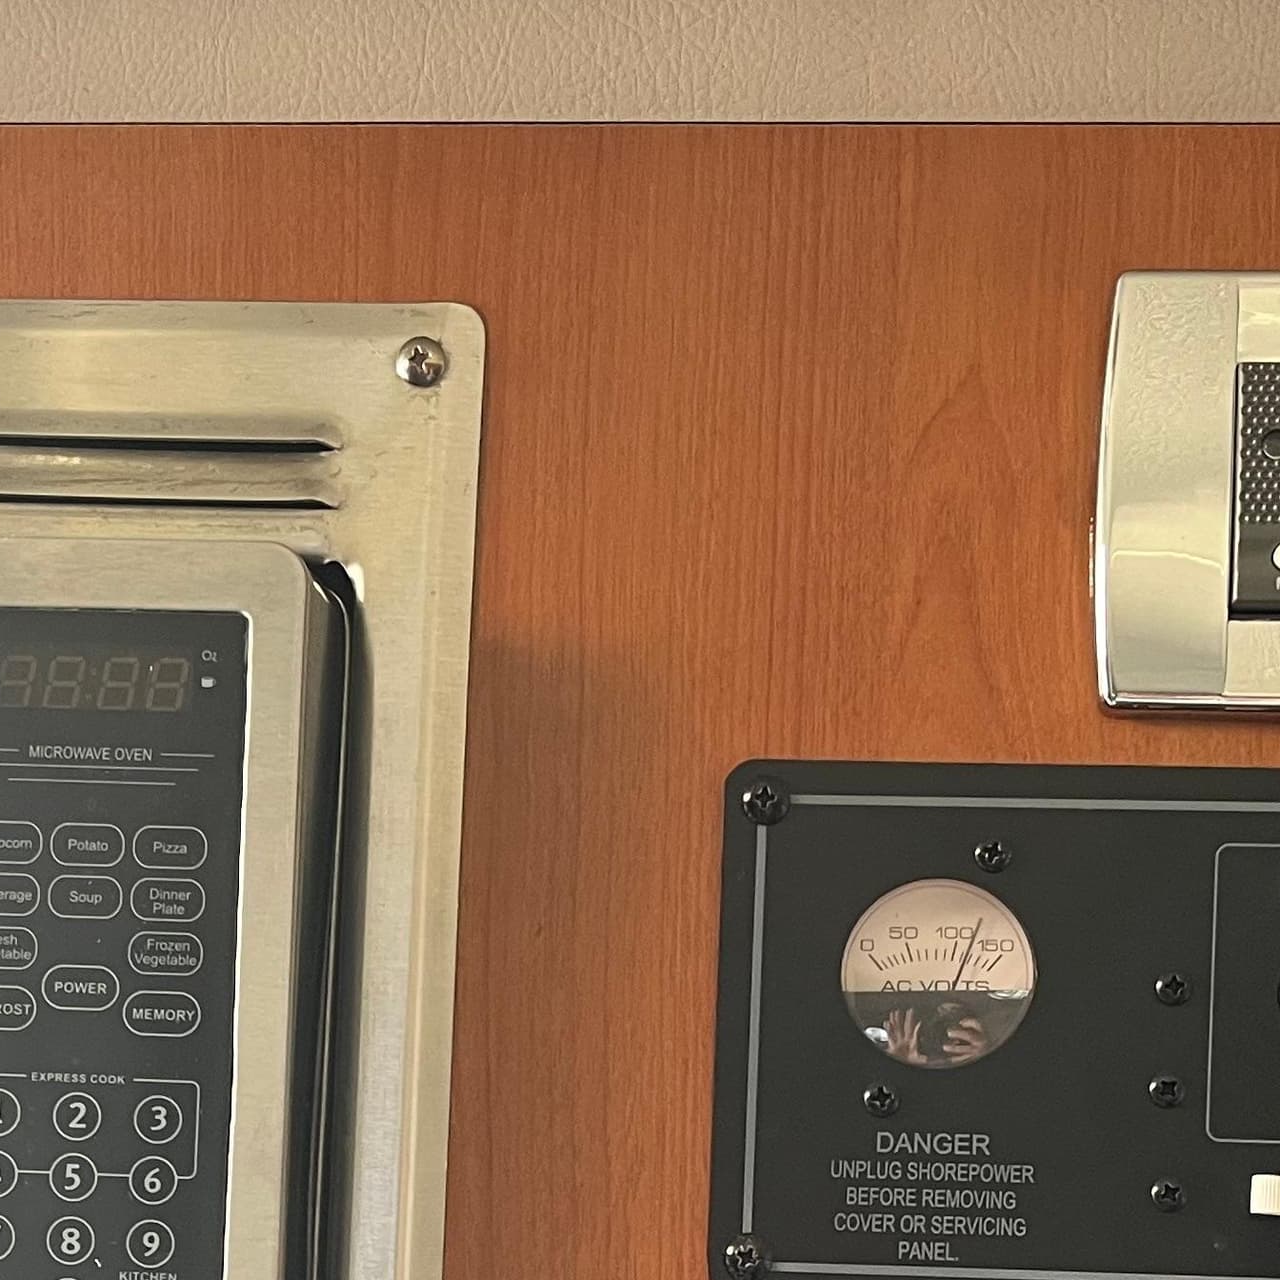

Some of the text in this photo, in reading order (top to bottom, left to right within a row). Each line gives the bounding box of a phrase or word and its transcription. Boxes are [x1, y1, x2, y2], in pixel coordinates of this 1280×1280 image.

[28, 745, 153, 762] MICROWAVE OVEN
[67, 838, 109, 852] Potato
[153, 841, 188, 855] Pizza
[69, 890, 103, 906] Soup
[149, 888, 191, 901] Dinner
[152, 902, 186, 916] Plate
[146, 939, 191, 953] Frozen
[860, 926, 1015, 952] 0 50 100 150
[134, 953, 198, 969] Vegetable
[54, 980, 108, 995] POWER
[880, 980, 911, 992] AC
[132, 1008, 195, 1022] MEMORY
[31, 1072, 126, 1085] EXPRESS COOK
[68, 1102, 88, 1130] 2
[150, 1105, 169, 1131] 3
[876, 1132, 990, 1156] DANGER
[64, 1164, 82, 1191] 5
[144, 1166, 162, 1193] 6
[830, 1160, 1034, 1184] UNPLUG SHOREPOWER
[846, 1187, 1017, 1210] BEFORE REMOVING
[834, 1212, 1027, 1237] COVER OR SERVICING
[60, 1227, 81, 1255] 8
[142, 1230, 161, 1257] 9
[898, 1241, 959, 1262] PANEL.
